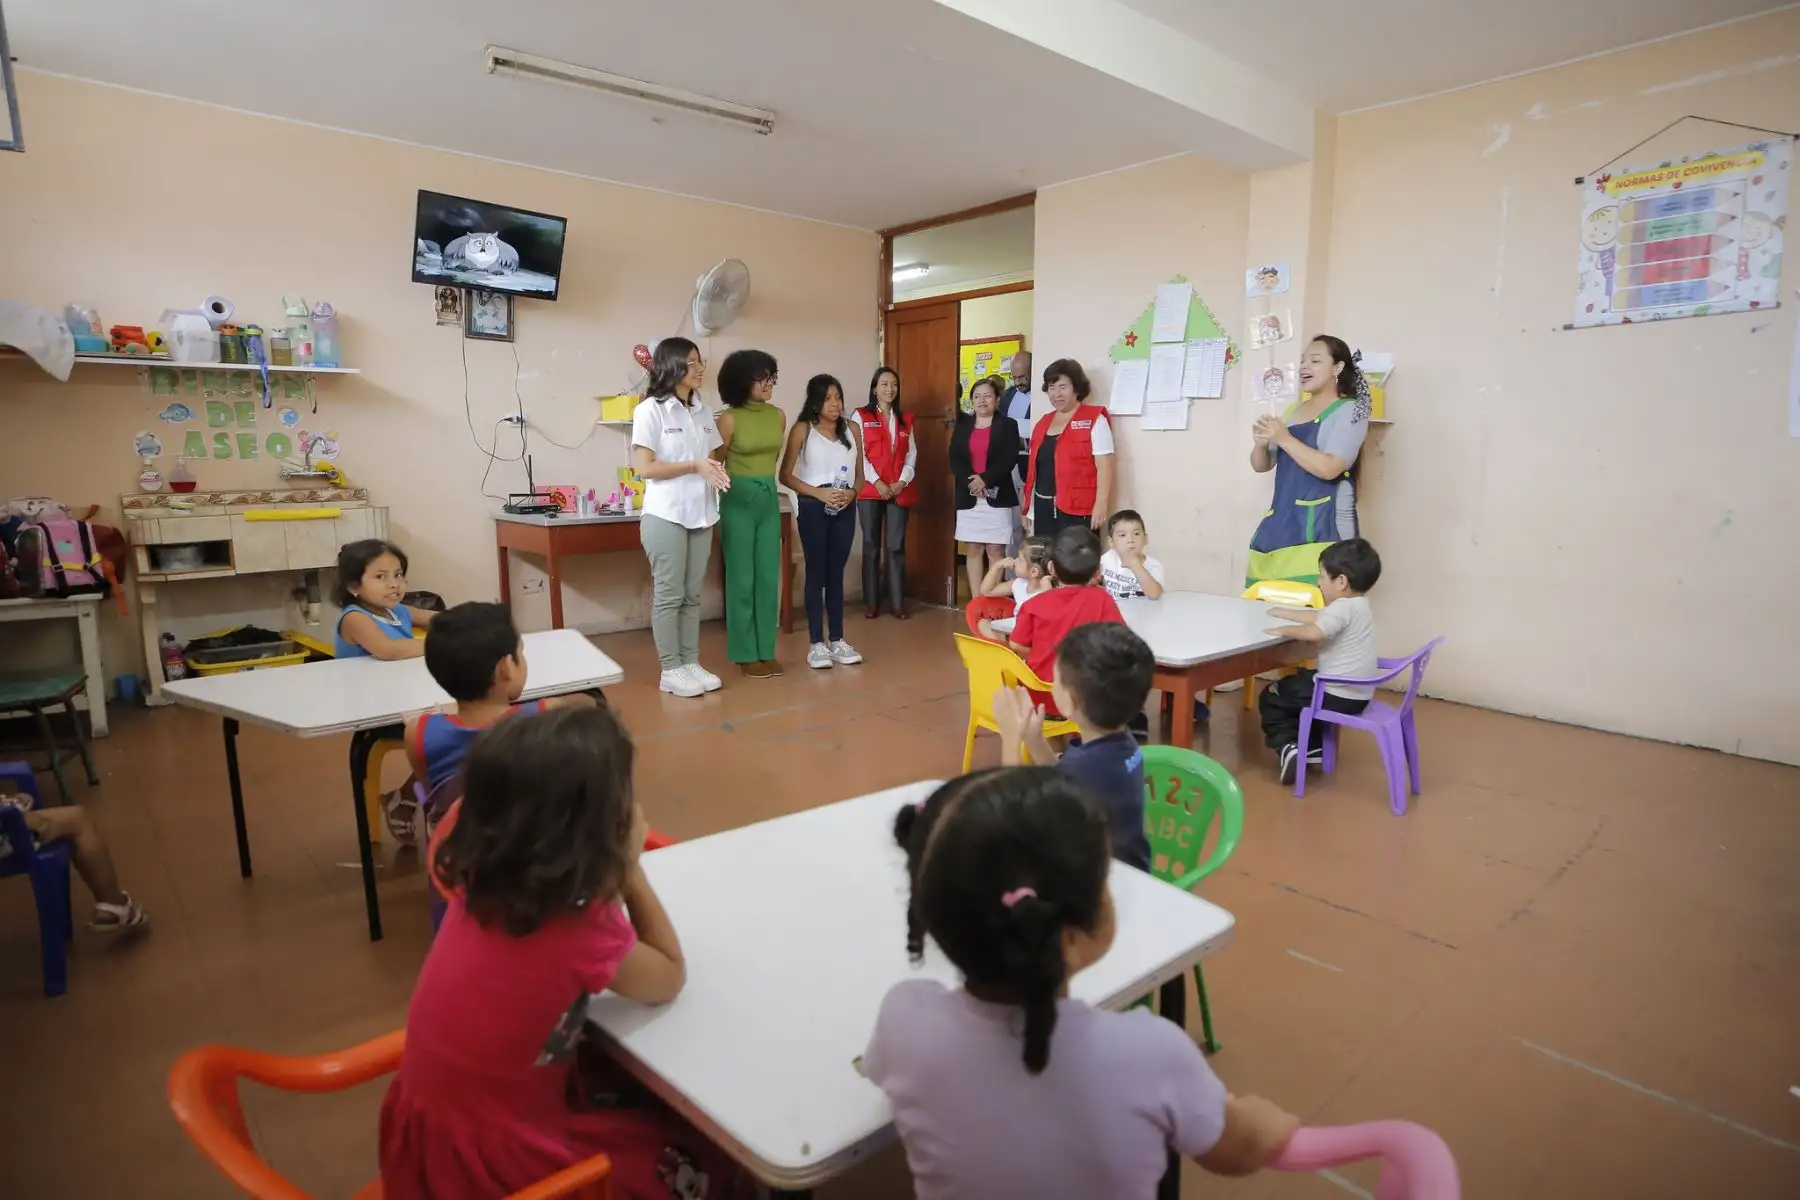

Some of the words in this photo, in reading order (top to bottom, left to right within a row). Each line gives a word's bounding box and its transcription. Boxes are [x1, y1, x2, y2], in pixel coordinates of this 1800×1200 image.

[1614, 173, 1665, 189] NORMAS
[1666, 169, 1681, 180] DE
[205, 400, 257, 428] DE
[181, 430, 293, 460] ASEO
